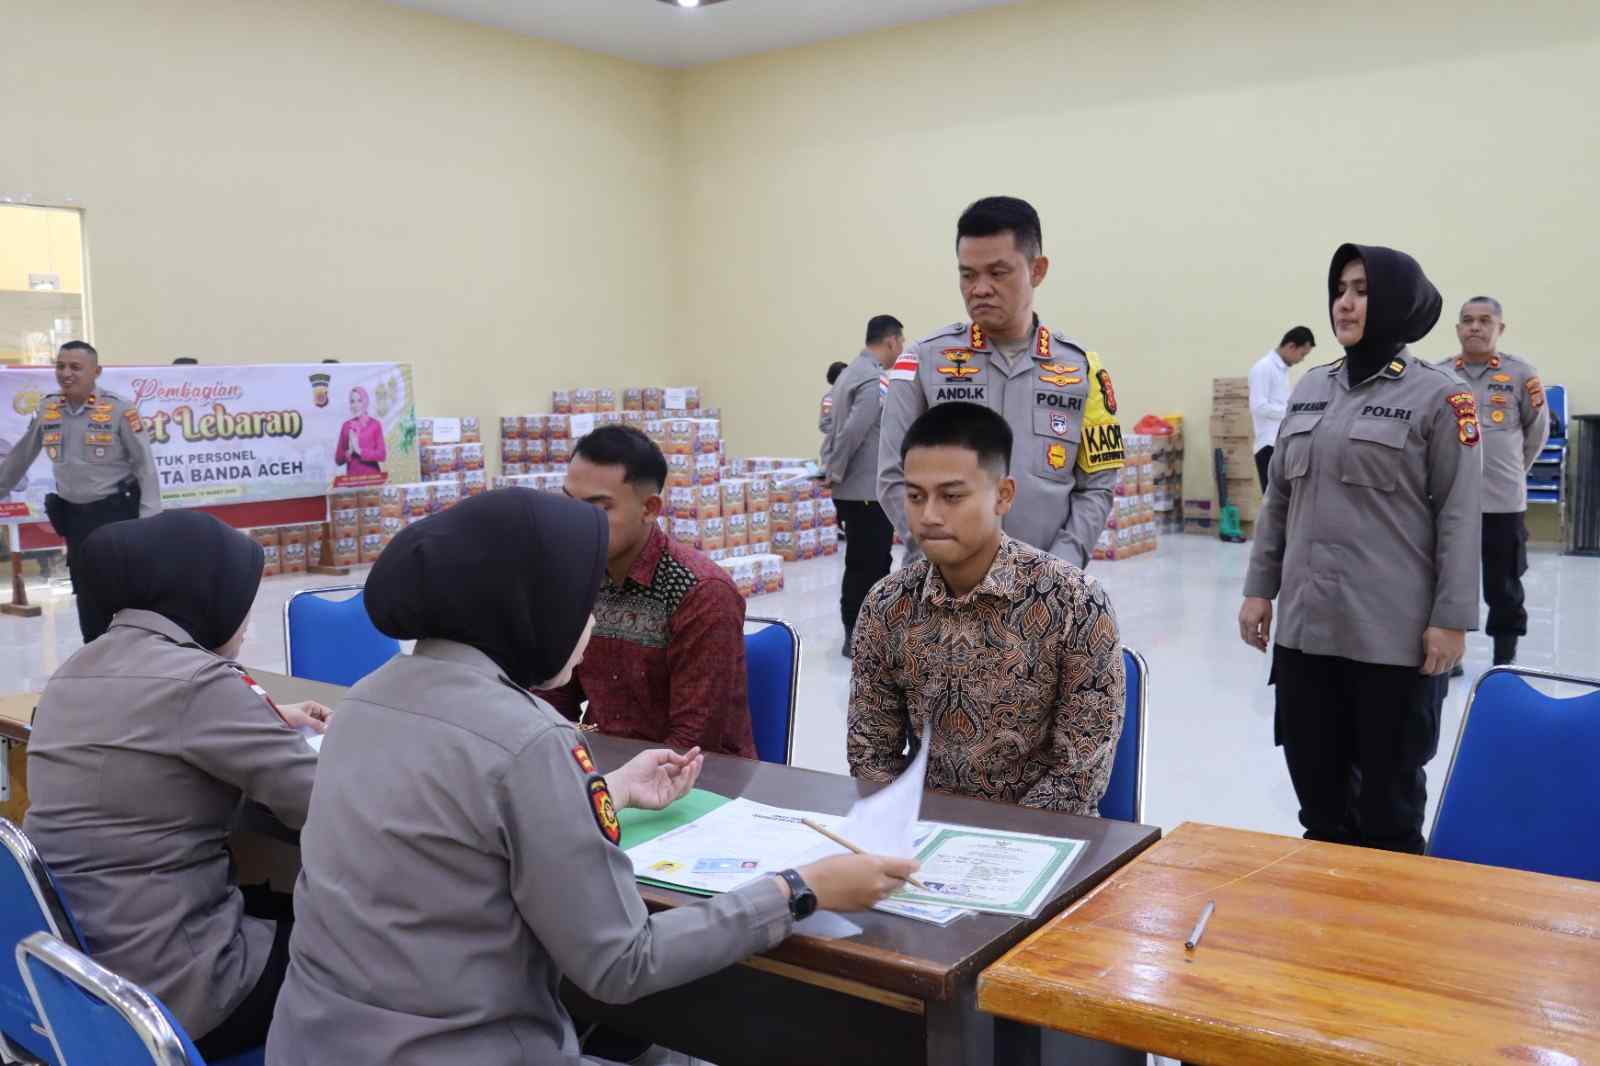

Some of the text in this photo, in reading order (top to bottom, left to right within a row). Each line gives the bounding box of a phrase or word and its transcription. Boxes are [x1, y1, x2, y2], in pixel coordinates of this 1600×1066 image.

[131, 379, 241, 403] Pembagian
[1036, 393, 1082, 411] POLRI
[172, 404, 303, 442] Lebaran
[1361, 406, 1412, 421] POLRI
[188, 450, 256, 465] PERSONEL
[191, 465, 252, 483] BANDA
[258, 461, 303, 478] ACEH
